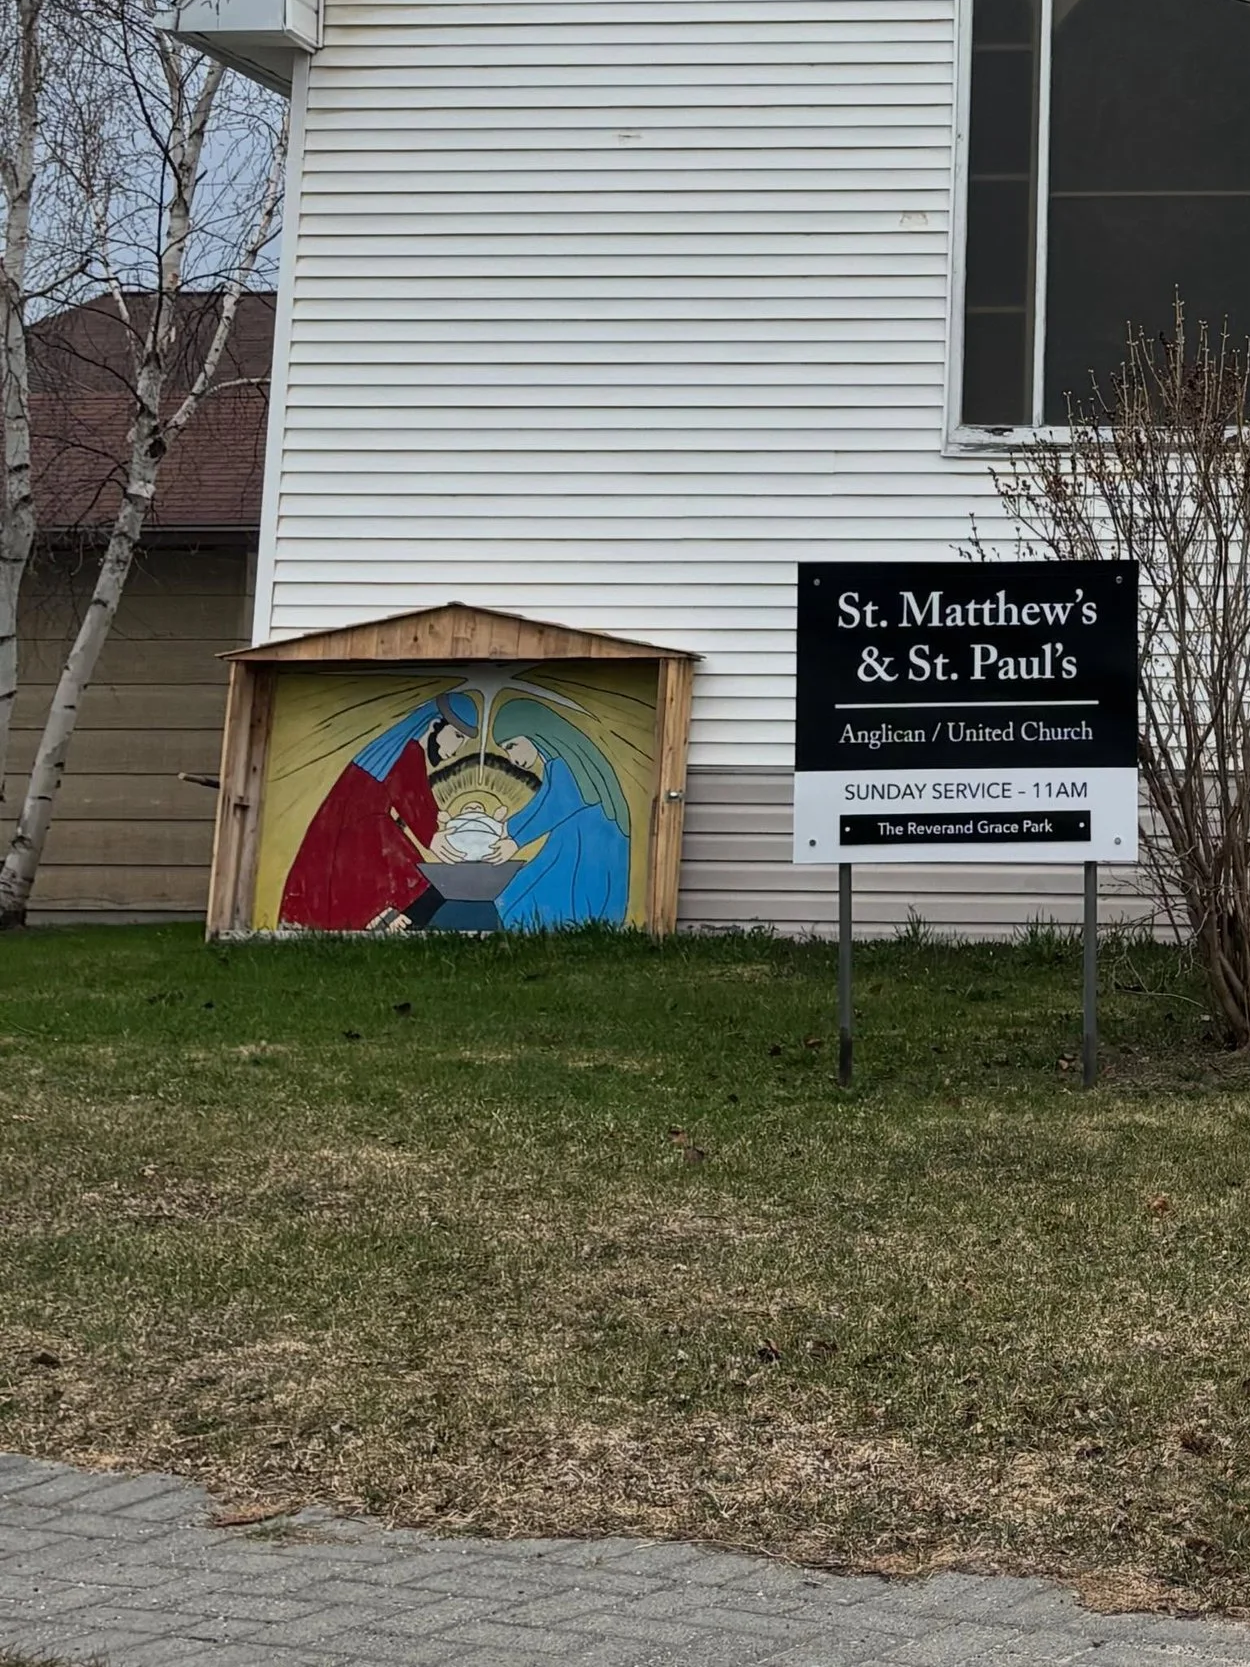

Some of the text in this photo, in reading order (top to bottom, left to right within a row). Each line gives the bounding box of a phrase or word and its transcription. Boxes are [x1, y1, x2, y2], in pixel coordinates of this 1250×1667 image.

[838, 588, 1098, 628] St. Matthew's
[857, 642, 1077, 682] & St. Paul's
[838, 721, 1093, 749] Anglican / United Church
[845, 783, 927, 801] SUNDAY
[932, 782, 1012, 799] SERVICE
[1032, 782, 1088, 798] 11AM
[877, 820, 1053, 836] The Reverand Grace Park
